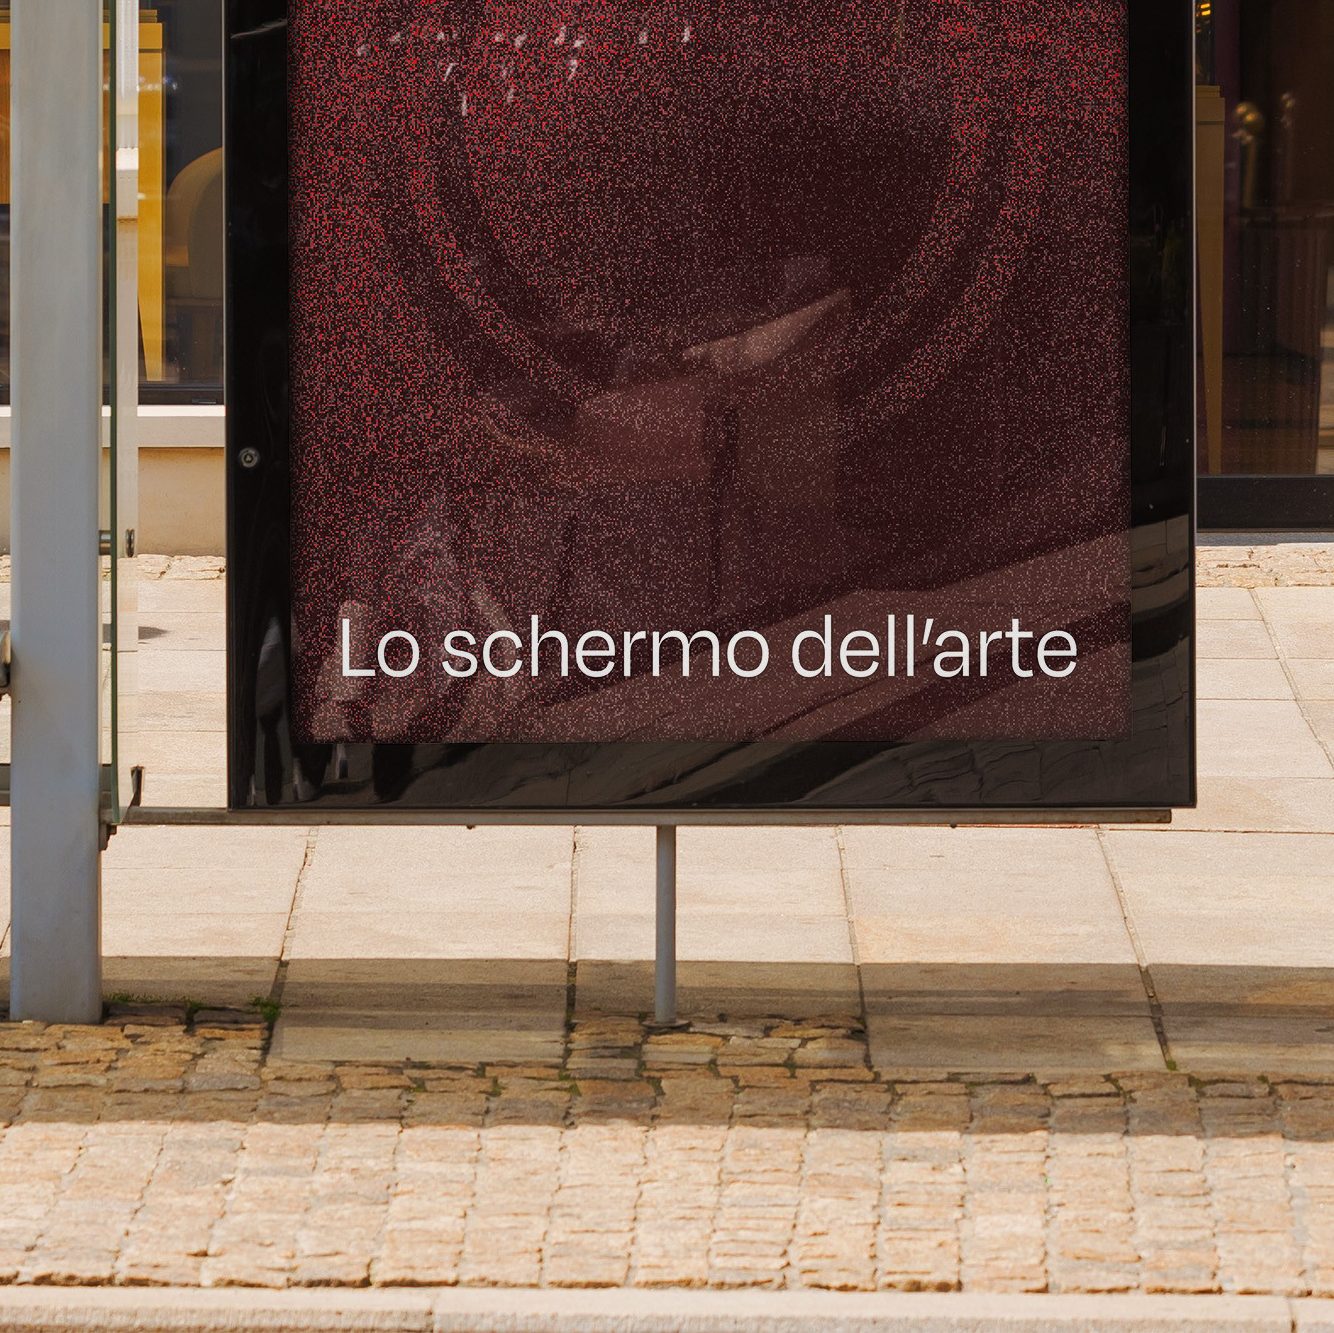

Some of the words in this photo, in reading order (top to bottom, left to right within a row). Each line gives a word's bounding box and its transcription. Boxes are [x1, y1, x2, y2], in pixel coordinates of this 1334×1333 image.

[340, 617, 420, 678] Lo
[441, 614, 770, 678] schermo
[791, 614, 1078, 678] dell'arte
